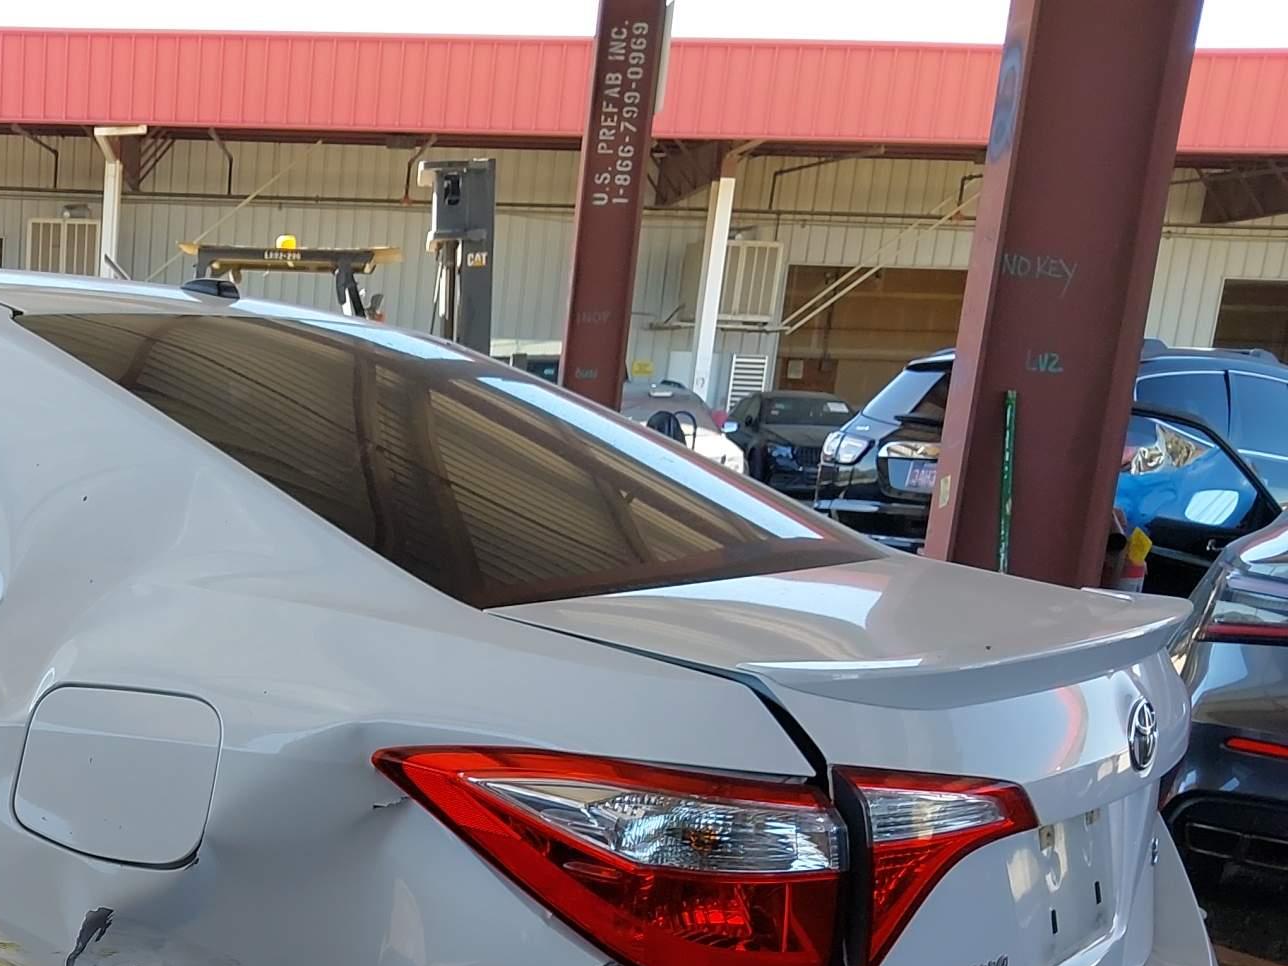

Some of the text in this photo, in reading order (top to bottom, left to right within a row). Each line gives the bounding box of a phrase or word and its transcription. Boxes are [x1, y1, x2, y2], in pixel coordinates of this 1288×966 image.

[592, 20, 629, 206] U.S. PREFAB INC.
[612, 22, 649, 204] 1-866-799-0969
[467, 251, 489, 268] CAT
[1002, 253, 1079, 299] NO KEY
